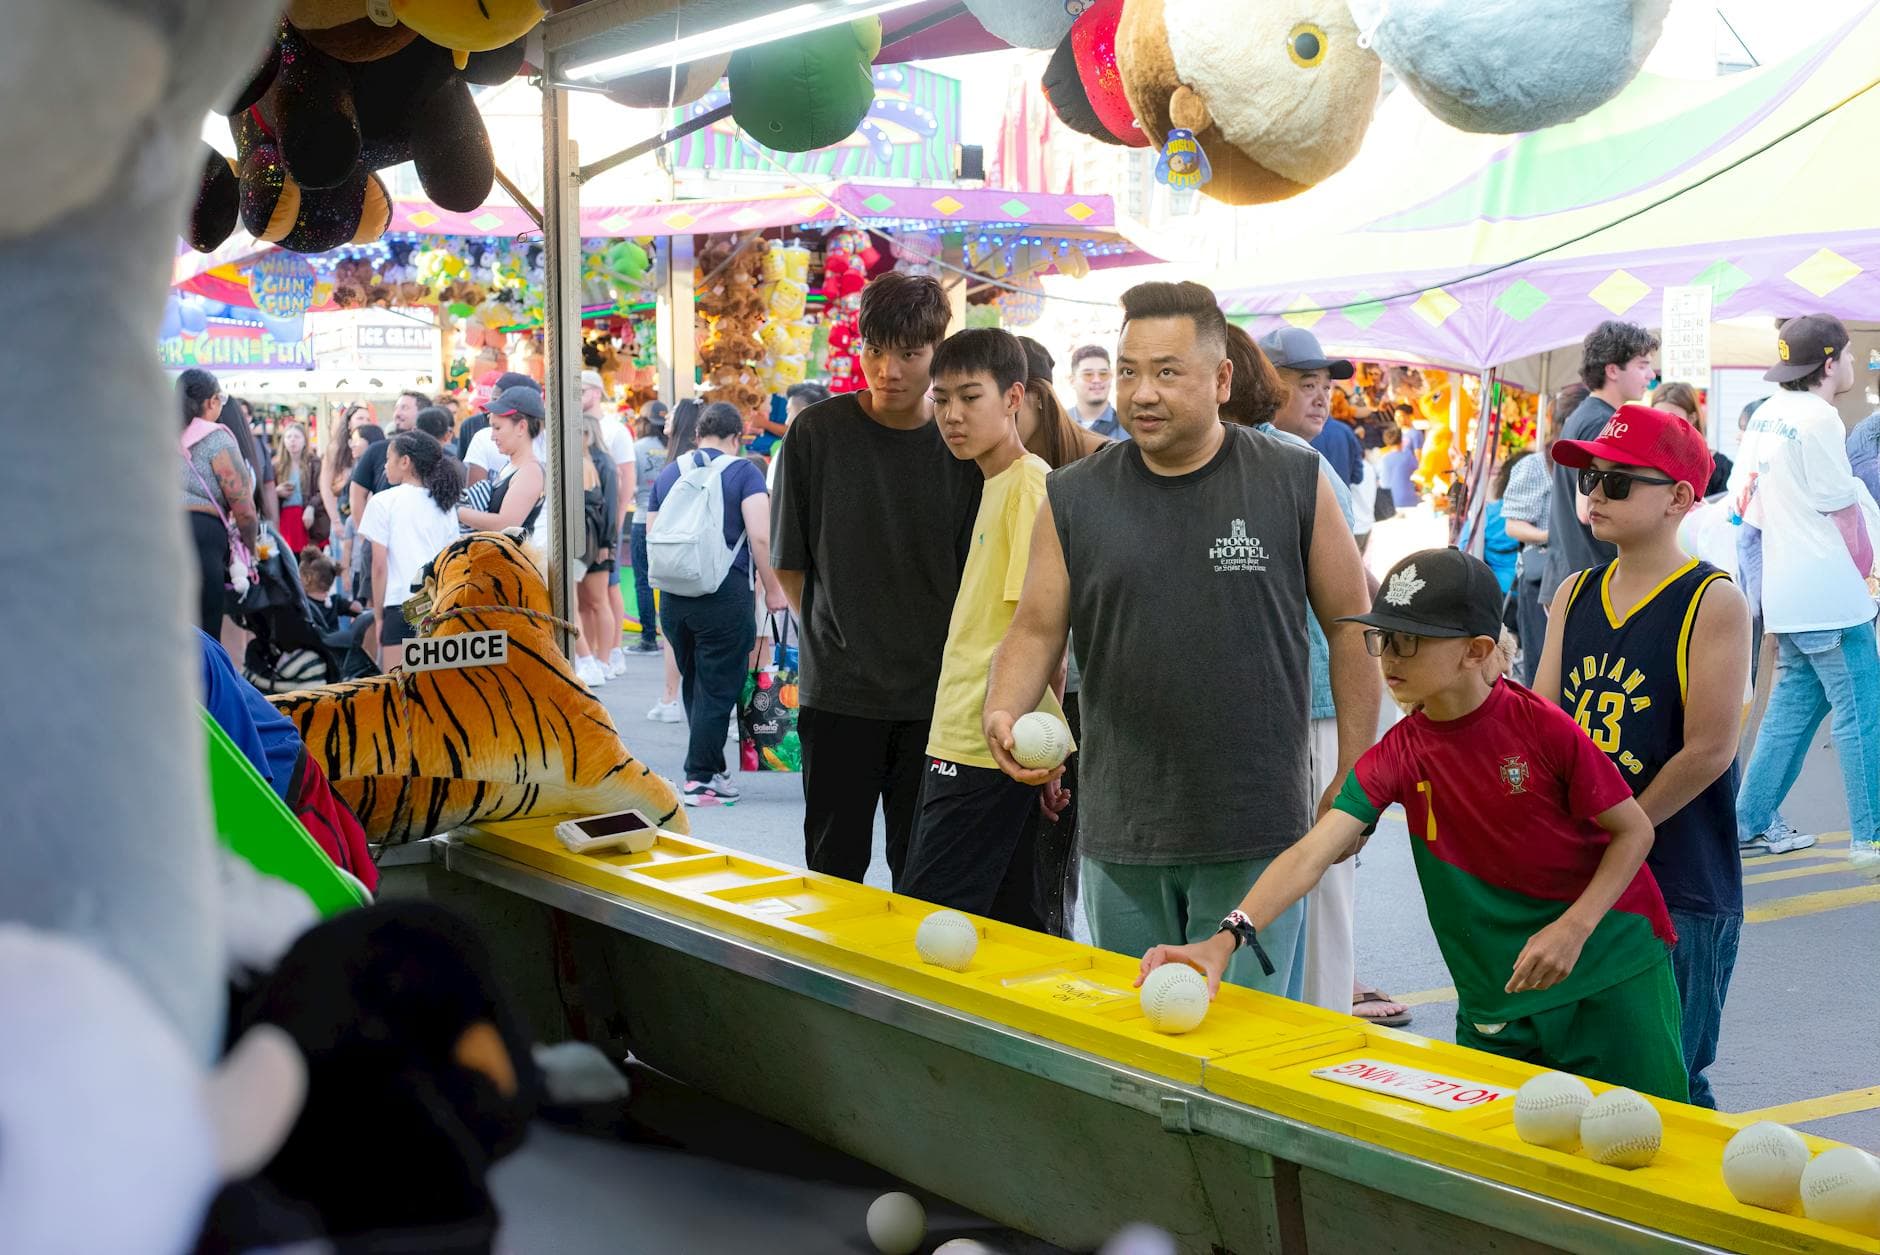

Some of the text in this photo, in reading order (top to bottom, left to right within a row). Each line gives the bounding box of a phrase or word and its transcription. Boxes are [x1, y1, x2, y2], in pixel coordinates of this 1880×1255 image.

[262, 274, 305, 294] GUN
[264, 294, 305, 313] FUN
[359, 326, 384, 347] ICE
[194, 331, 250, 364] GUN
[261, 333, 315, 364] FUN
[1215, 537, 1260, 547] MOMO
[1209, 546, 1270, 559] HOTEL
[405, 635, 503, 667] CHOICE
[1563, 653, 1652, 713] INDIANA
[1573, 689, 1626, 753] 43
[930, 759, 958, 777] FILA
[1416, 780, 1438, 841] 7
[1452, 1088, 1500, 1105] NO
